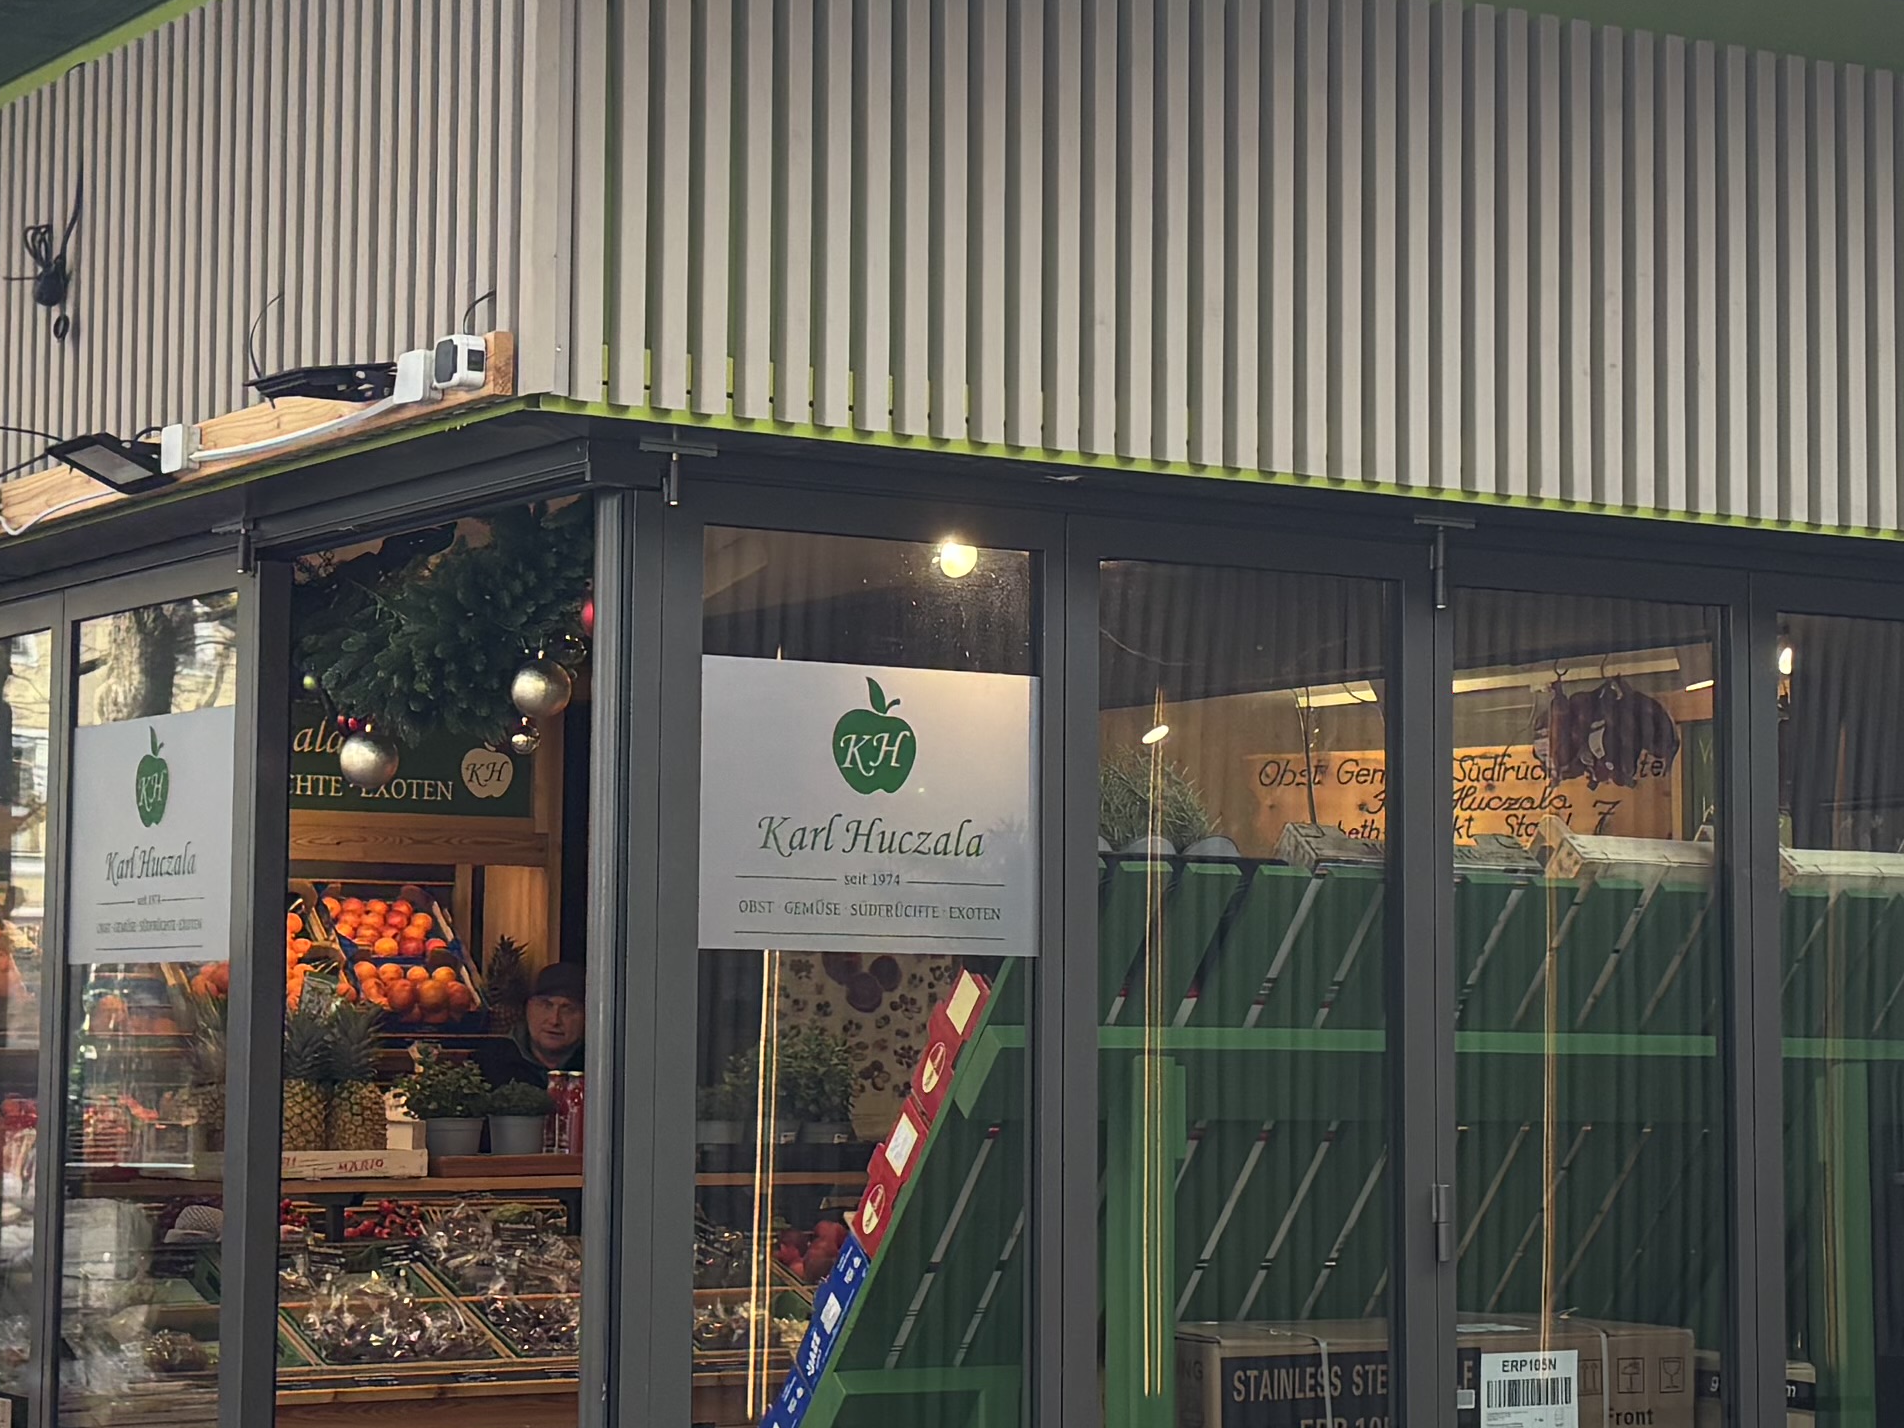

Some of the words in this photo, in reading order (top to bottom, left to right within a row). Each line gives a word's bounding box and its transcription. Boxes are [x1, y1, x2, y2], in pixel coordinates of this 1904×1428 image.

[840, 729, 911, 777] KH
[136, 768, 167, 812] KH
[465, 761, 511, 787] KH
[758, 813, 842, 857] Karl
[841, 817, 985, 858] Huczala
[105, 845, 139, 886] Karl
[137, 840, 197, 879] Huczala
[844, 873, 867, 886] seit
[872, 873, 900, 887] 1974
[738, 899, 775, 914] OBST
[784, 899, 841, 917] GEMÜSE
[850, 900, 940, 919] SÜDFRÜCHTE
[949, 906, 1001, 920] EXOTEN
[1352, 1363, 1389, 1397] STE
[1501, 1357, 1557, 1373] ERP105N
